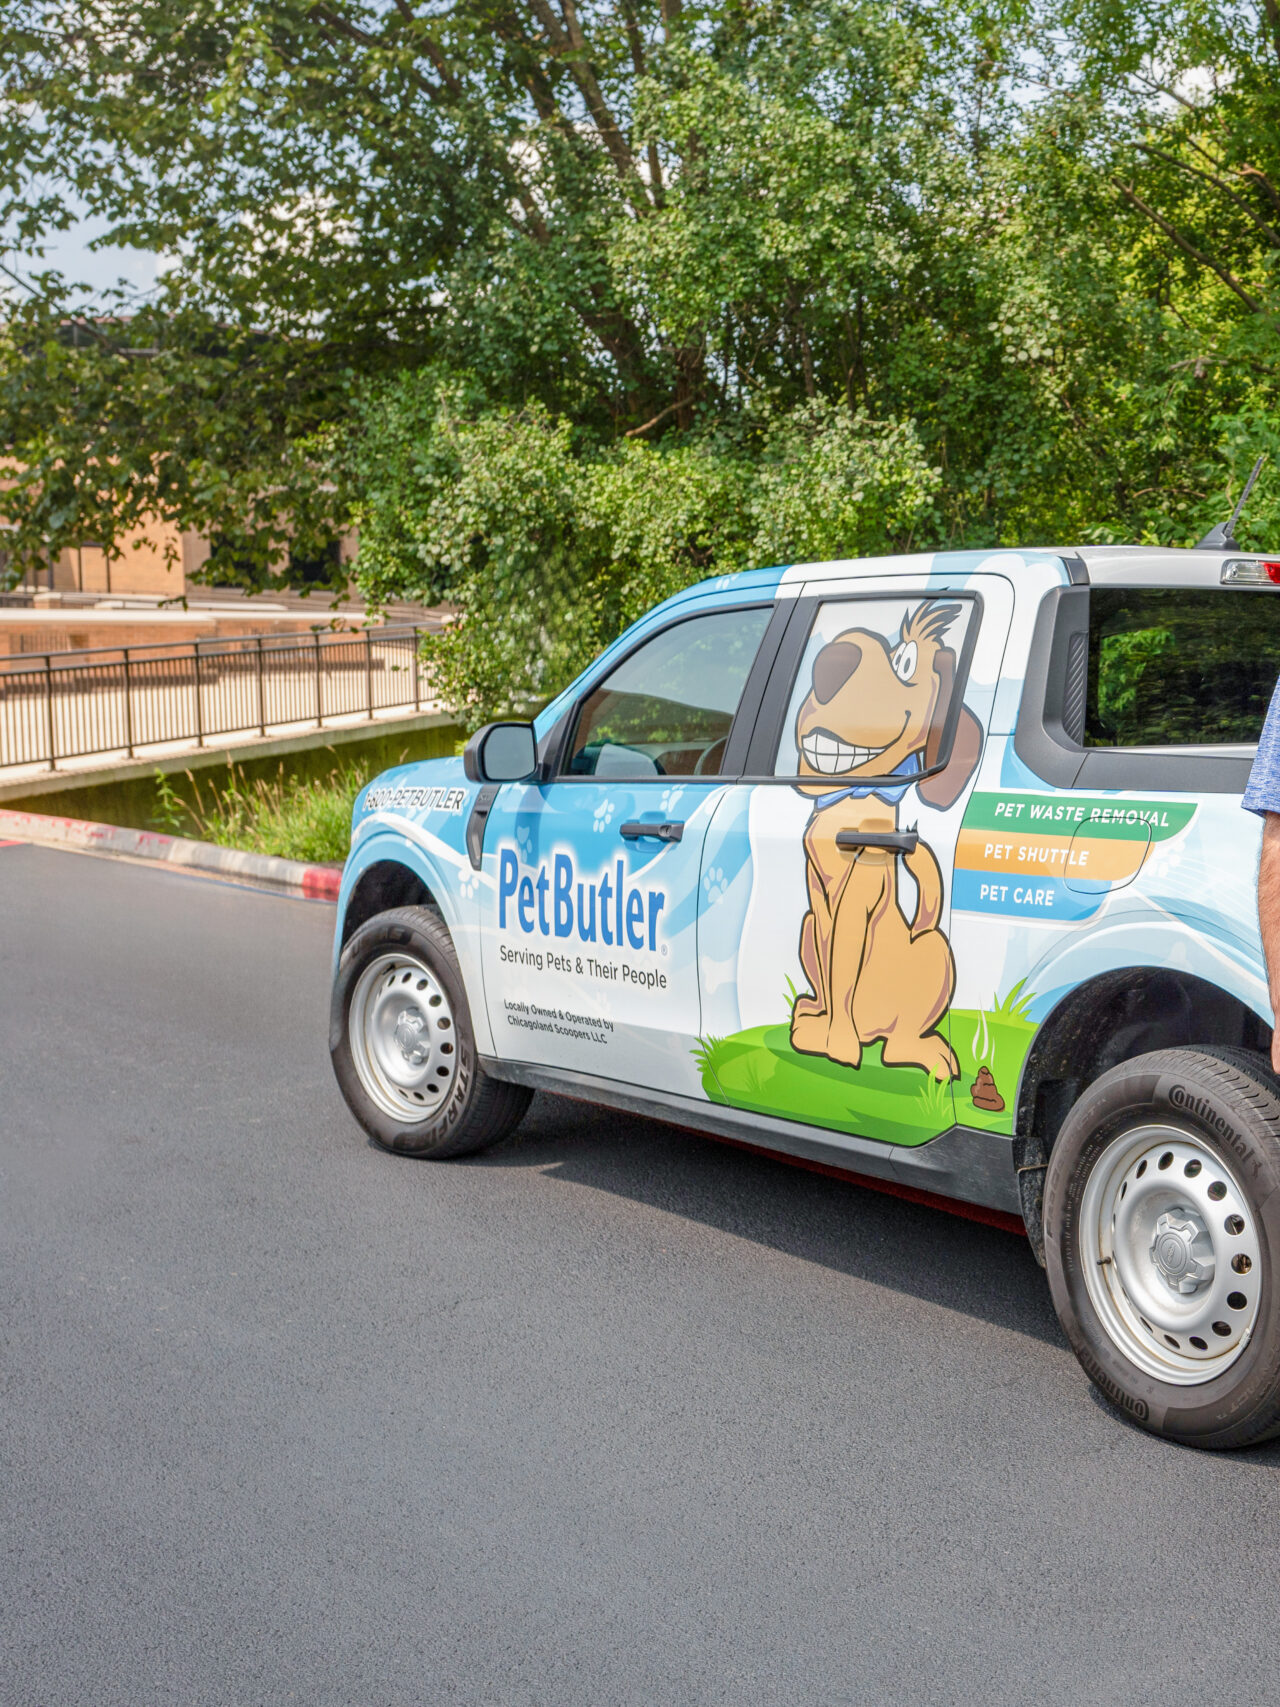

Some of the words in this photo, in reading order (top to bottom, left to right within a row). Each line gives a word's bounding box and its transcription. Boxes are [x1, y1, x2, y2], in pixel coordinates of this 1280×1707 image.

[994, 802, 1025, 818] PET
[1030, 804, 1085, 822] WASTE
[1089, 807, 1170, 828] REMOVAL
[984, 843, 1013, 859] PET
[1017, 846, 1090, 866] SHUTTLE
[499, 848, 665, 952] PetButler
[980, 884, 1009, 901] PET
[1013, 887, 1055, 907] CARE
[500, 944, 543, 971] Serving
[547, 952, 572, 972] Pets
[575, 956, 584, 975] &
[587, 958, 618, 980] Their
[622, 964, 667, 990] People
[504, 999, 529, 1015] Locally
[531, 1004, 556, 1018] Owned
[558, 1010, 564, 1020] &
[565, 1012, 602, 1028] Operated
[603, 1018, 614, 1032] by
[507, 1015, 552, 1032] Chicagoland
[554, 1025, 591, 1041] Scoopers
[591, 1031, 608, 1044] LLC
[1168, 1084, 1256, 1163] Continental
